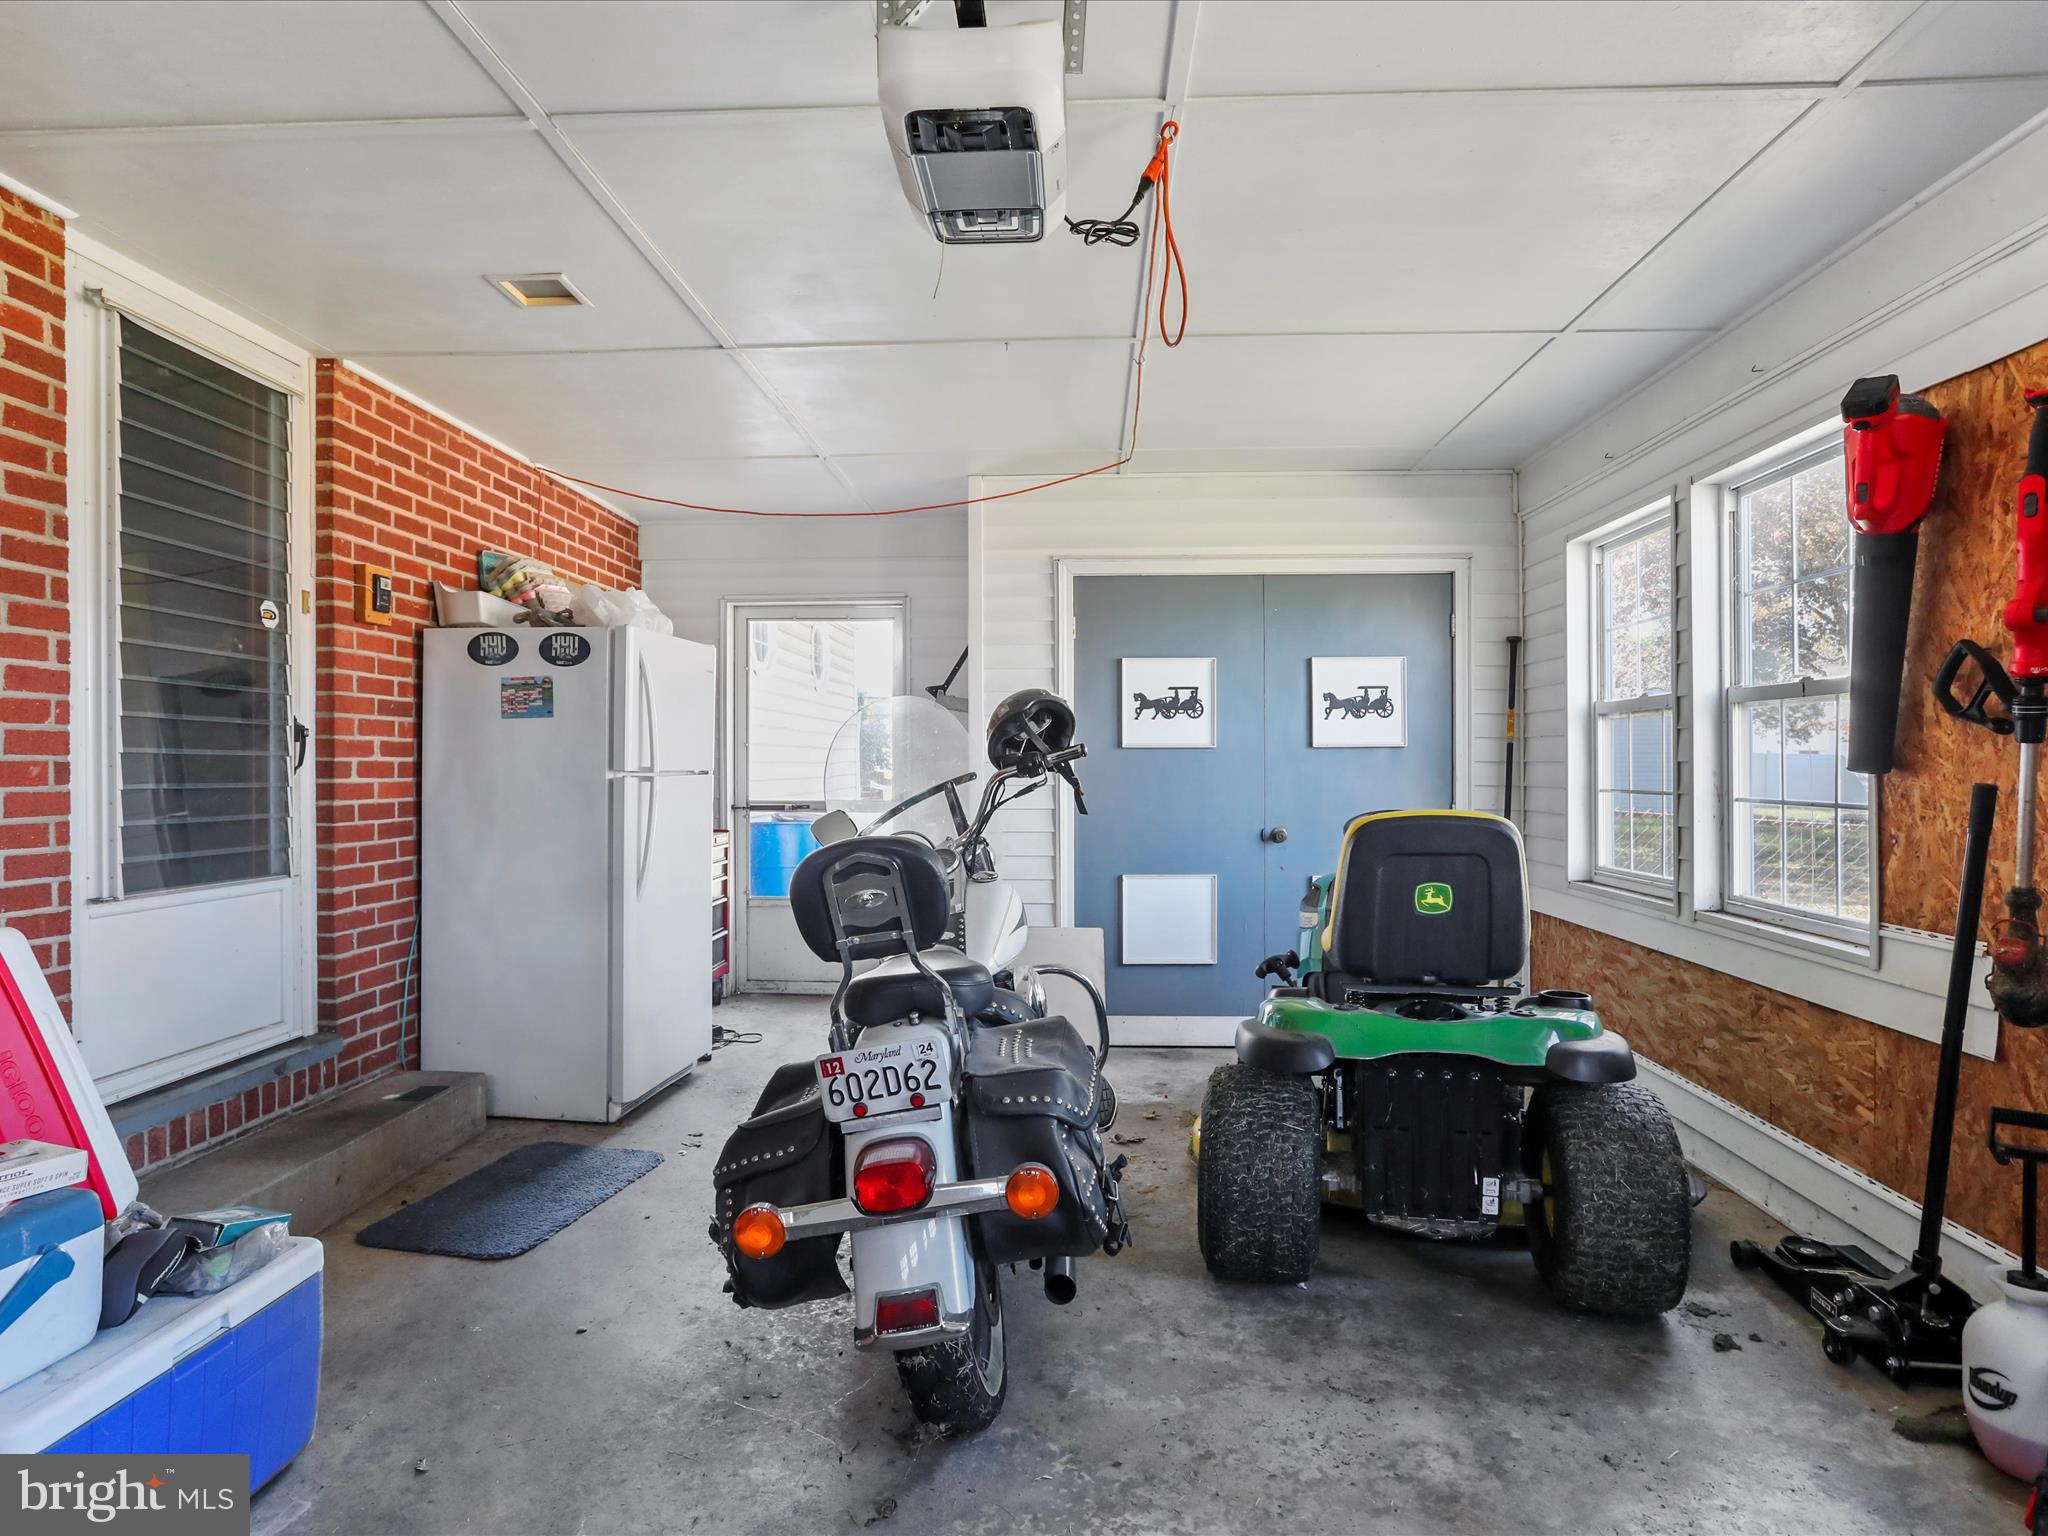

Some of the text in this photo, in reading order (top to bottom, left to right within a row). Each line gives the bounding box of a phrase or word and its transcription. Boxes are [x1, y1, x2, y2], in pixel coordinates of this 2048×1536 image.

[854, 1045, 902, 1064] Maryland
[918, 1042, 934, 1055] 24
[825, 1062, 842, 1075] 12
[828, 1059, 942, 1106] 602D62
